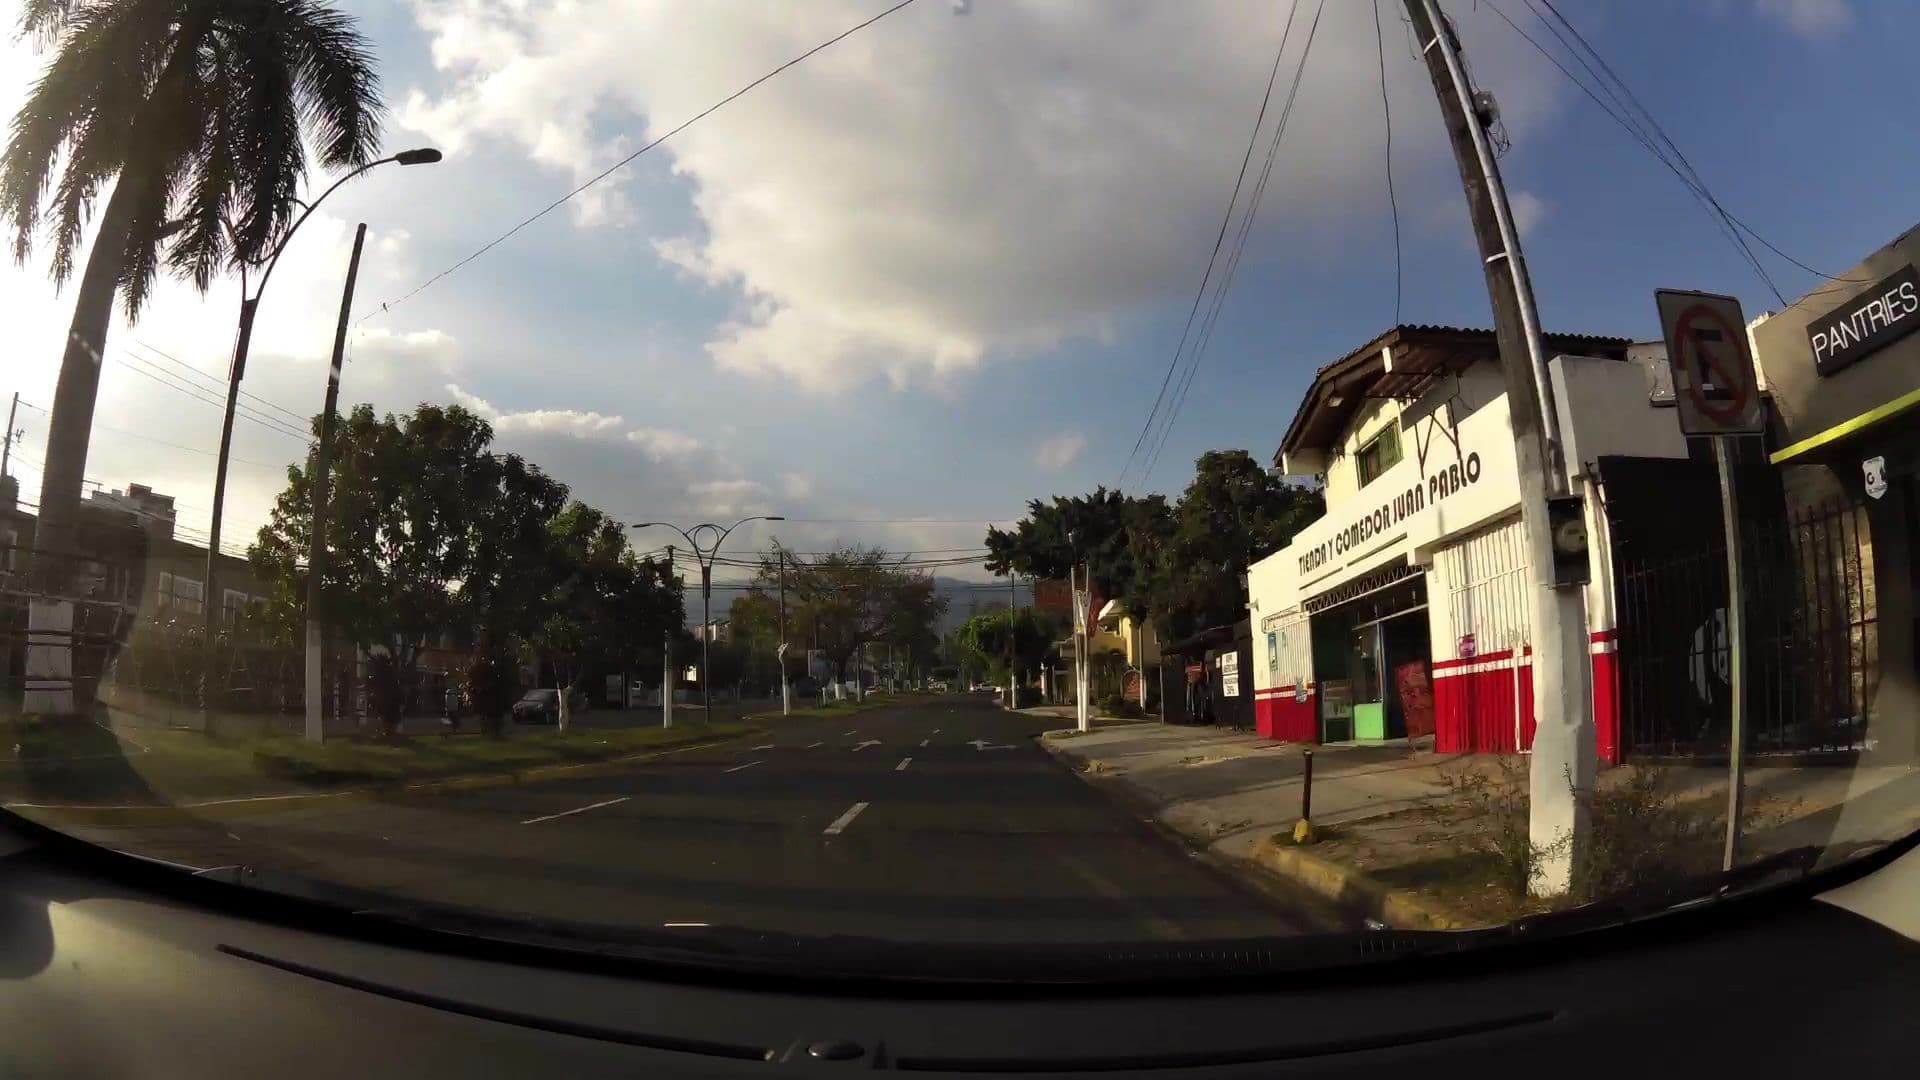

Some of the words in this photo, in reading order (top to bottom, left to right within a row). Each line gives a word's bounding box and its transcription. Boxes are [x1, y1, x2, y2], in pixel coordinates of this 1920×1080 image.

[1811, 282, 1918, 363] PANTRIES
[1298, 542, 1327, 576] TIENDA
[1327, 538, 1334, 561] Y
[1336, 504, 1391, 555] COMEDOR
[1393, 483, 1424, 525] JUAN
[1429, 452, 1481, 505] PABLO
